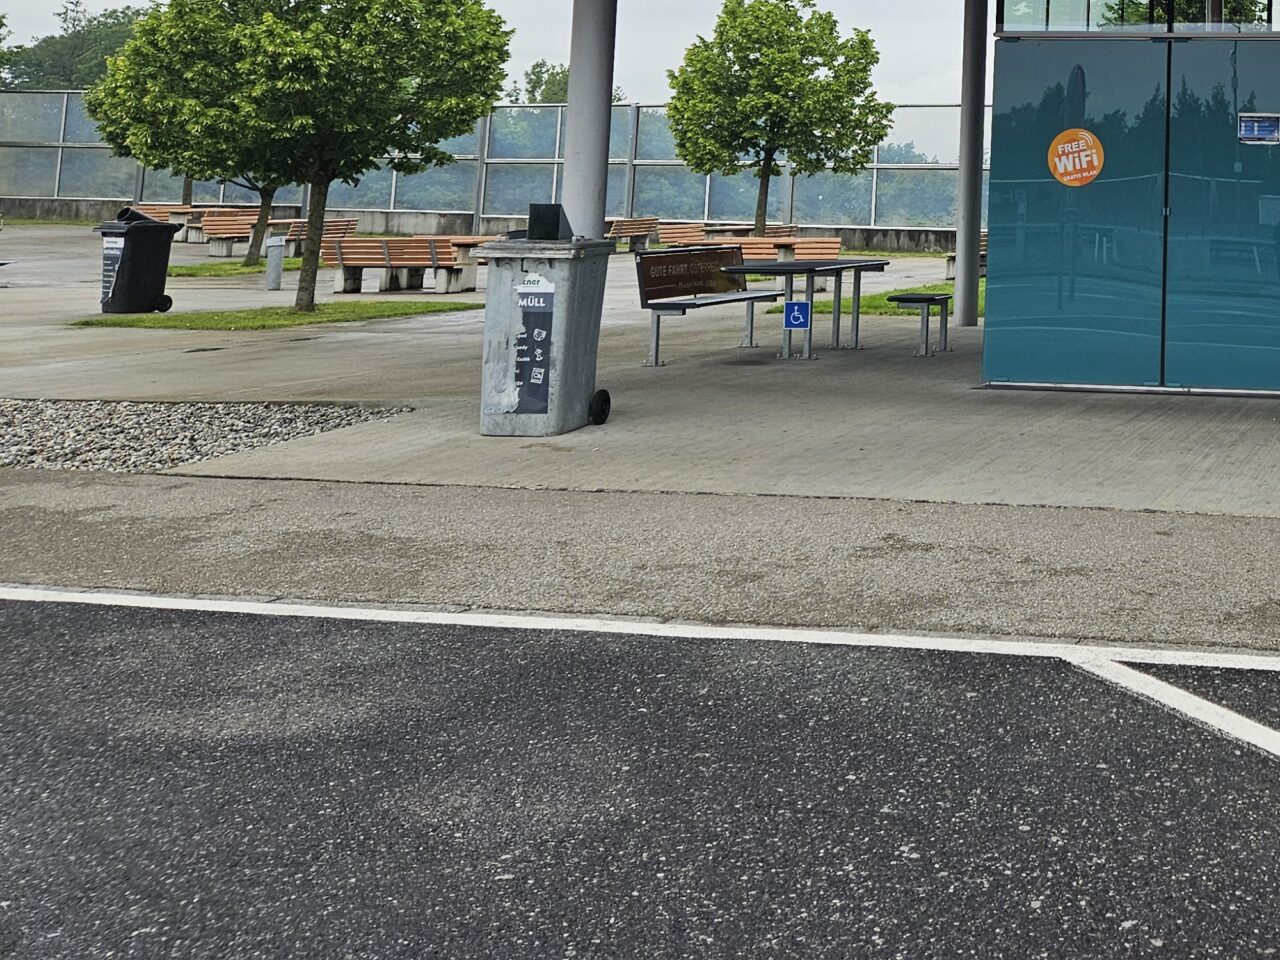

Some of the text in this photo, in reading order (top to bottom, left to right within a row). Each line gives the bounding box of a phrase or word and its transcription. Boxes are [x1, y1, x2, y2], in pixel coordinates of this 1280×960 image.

[1057, 140, 1087, 155] FREE
[1054, 149, 1098, 173] WiFi
[650, 264, 667, 278] GUTE
